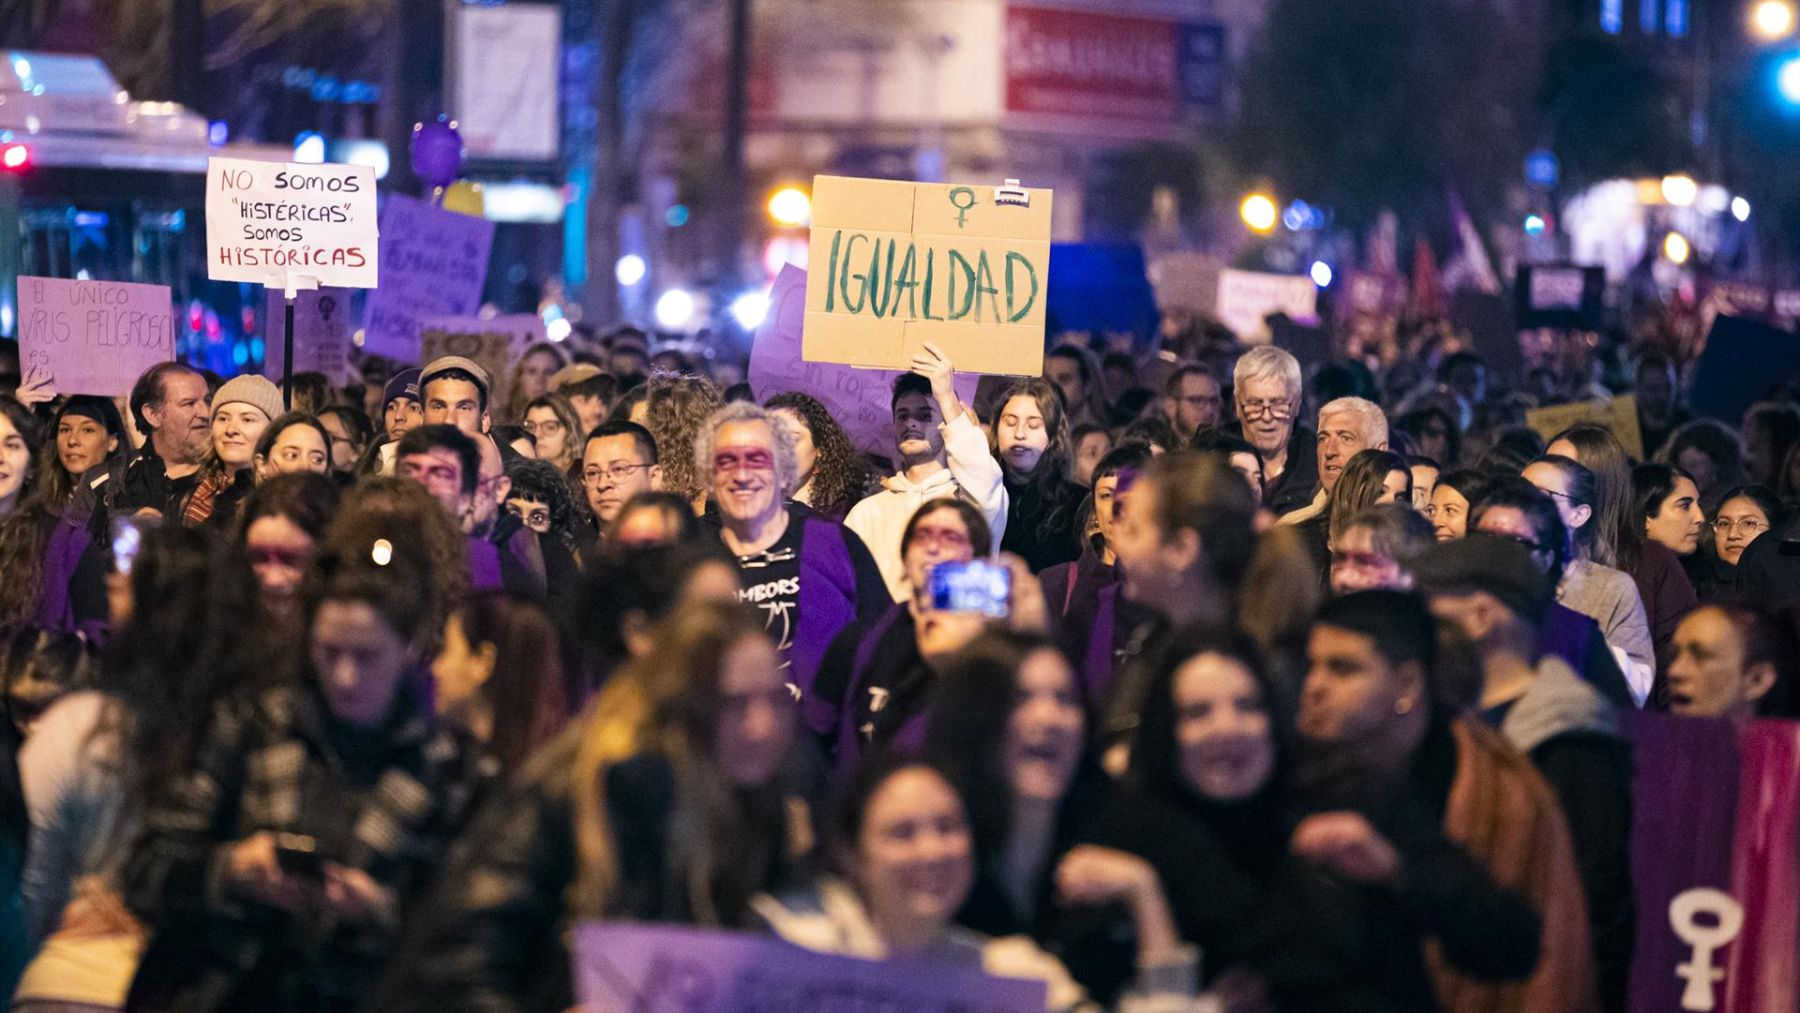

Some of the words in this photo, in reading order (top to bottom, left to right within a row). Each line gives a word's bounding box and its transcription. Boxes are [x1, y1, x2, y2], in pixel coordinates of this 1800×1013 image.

[221, 169, 254, 191] NO
[825, 229, 1039, 325] IGUALDAD
[732, 576, 800, 604] MBORS
